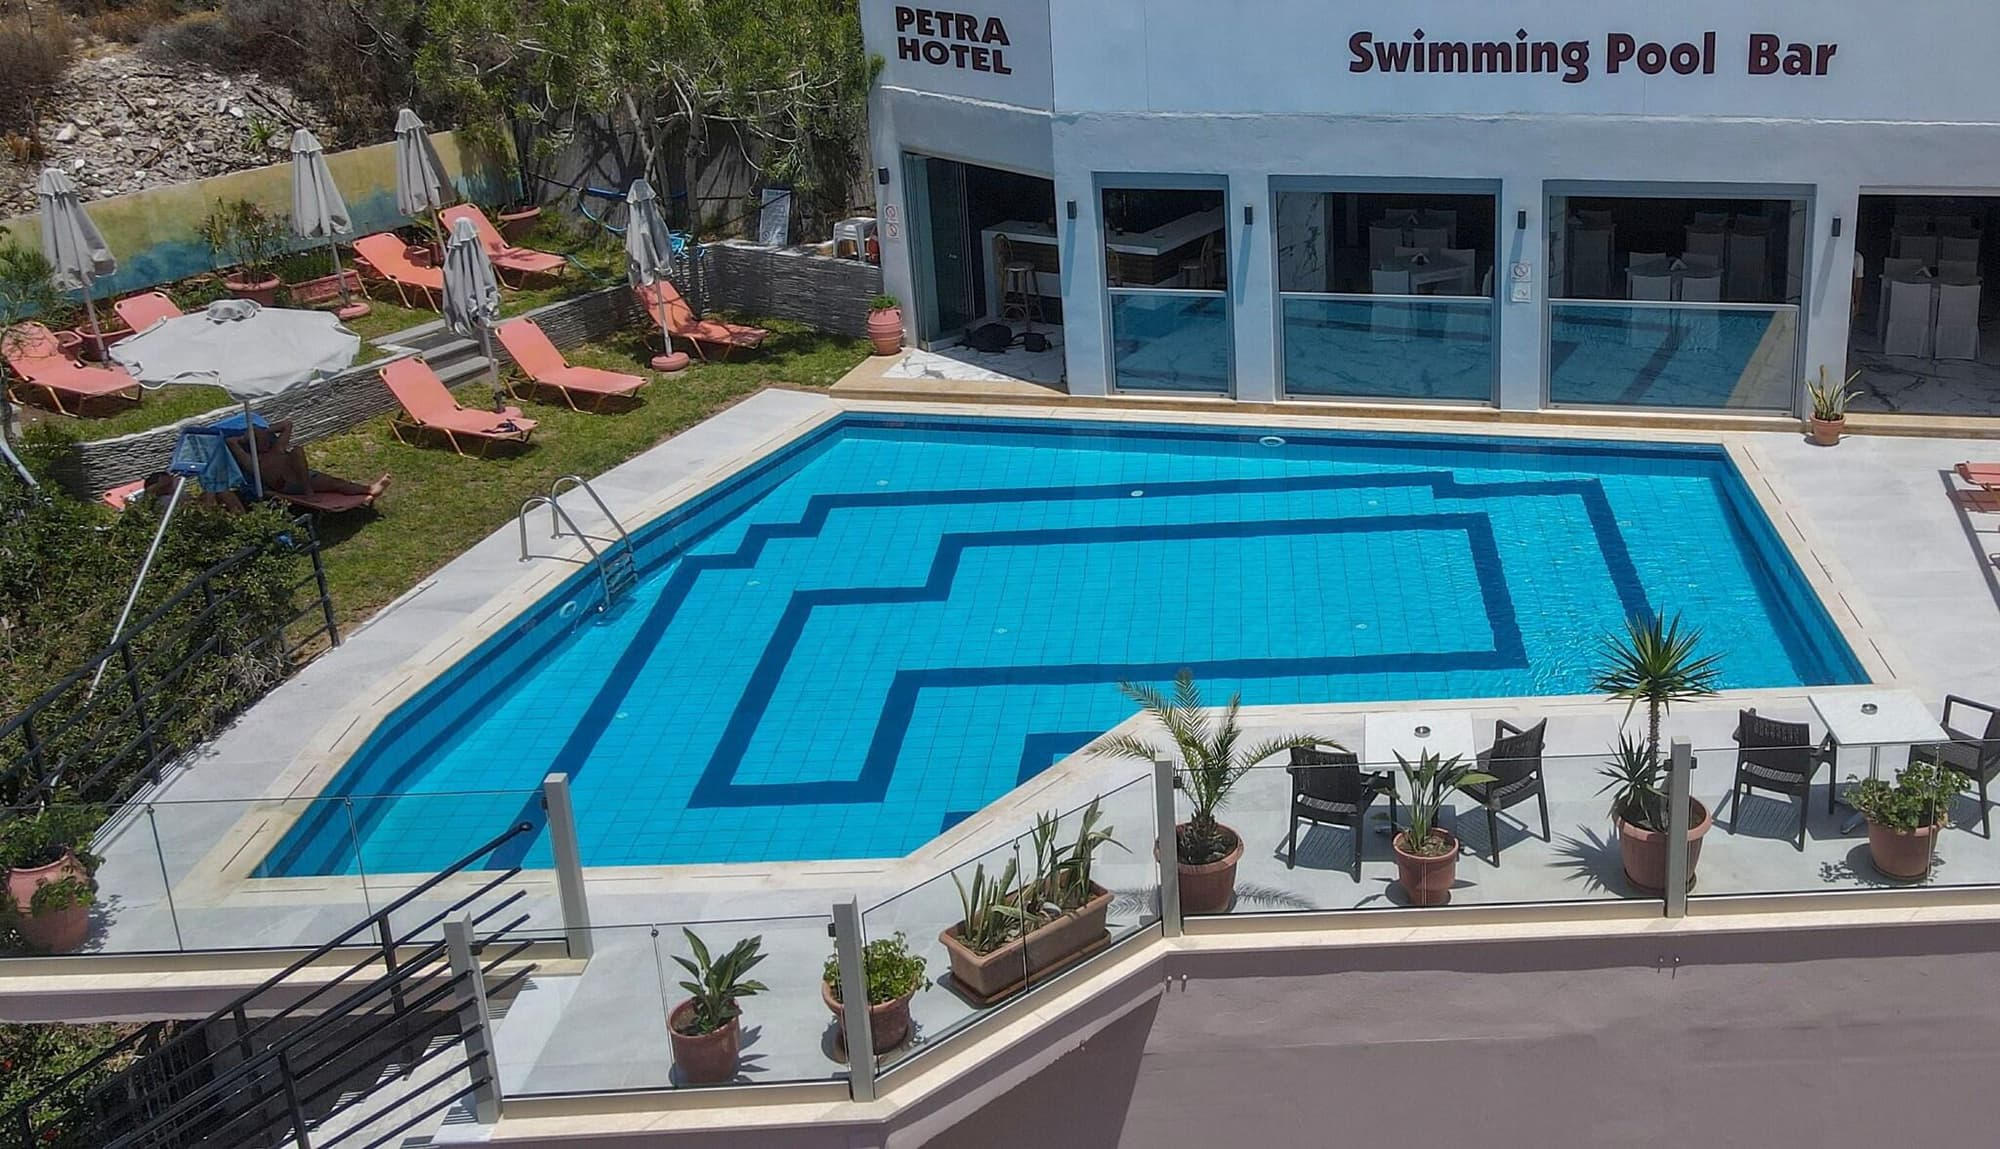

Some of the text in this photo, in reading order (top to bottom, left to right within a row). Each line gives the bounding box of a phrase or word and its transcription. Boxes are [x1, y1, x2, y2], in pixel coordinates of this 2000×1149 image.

[895, 6, 1010, 46] PETRA
[897, 36, 1013, 75] HOTEL
[1349, 28, 1838, 83] Swimming Pool Bar
